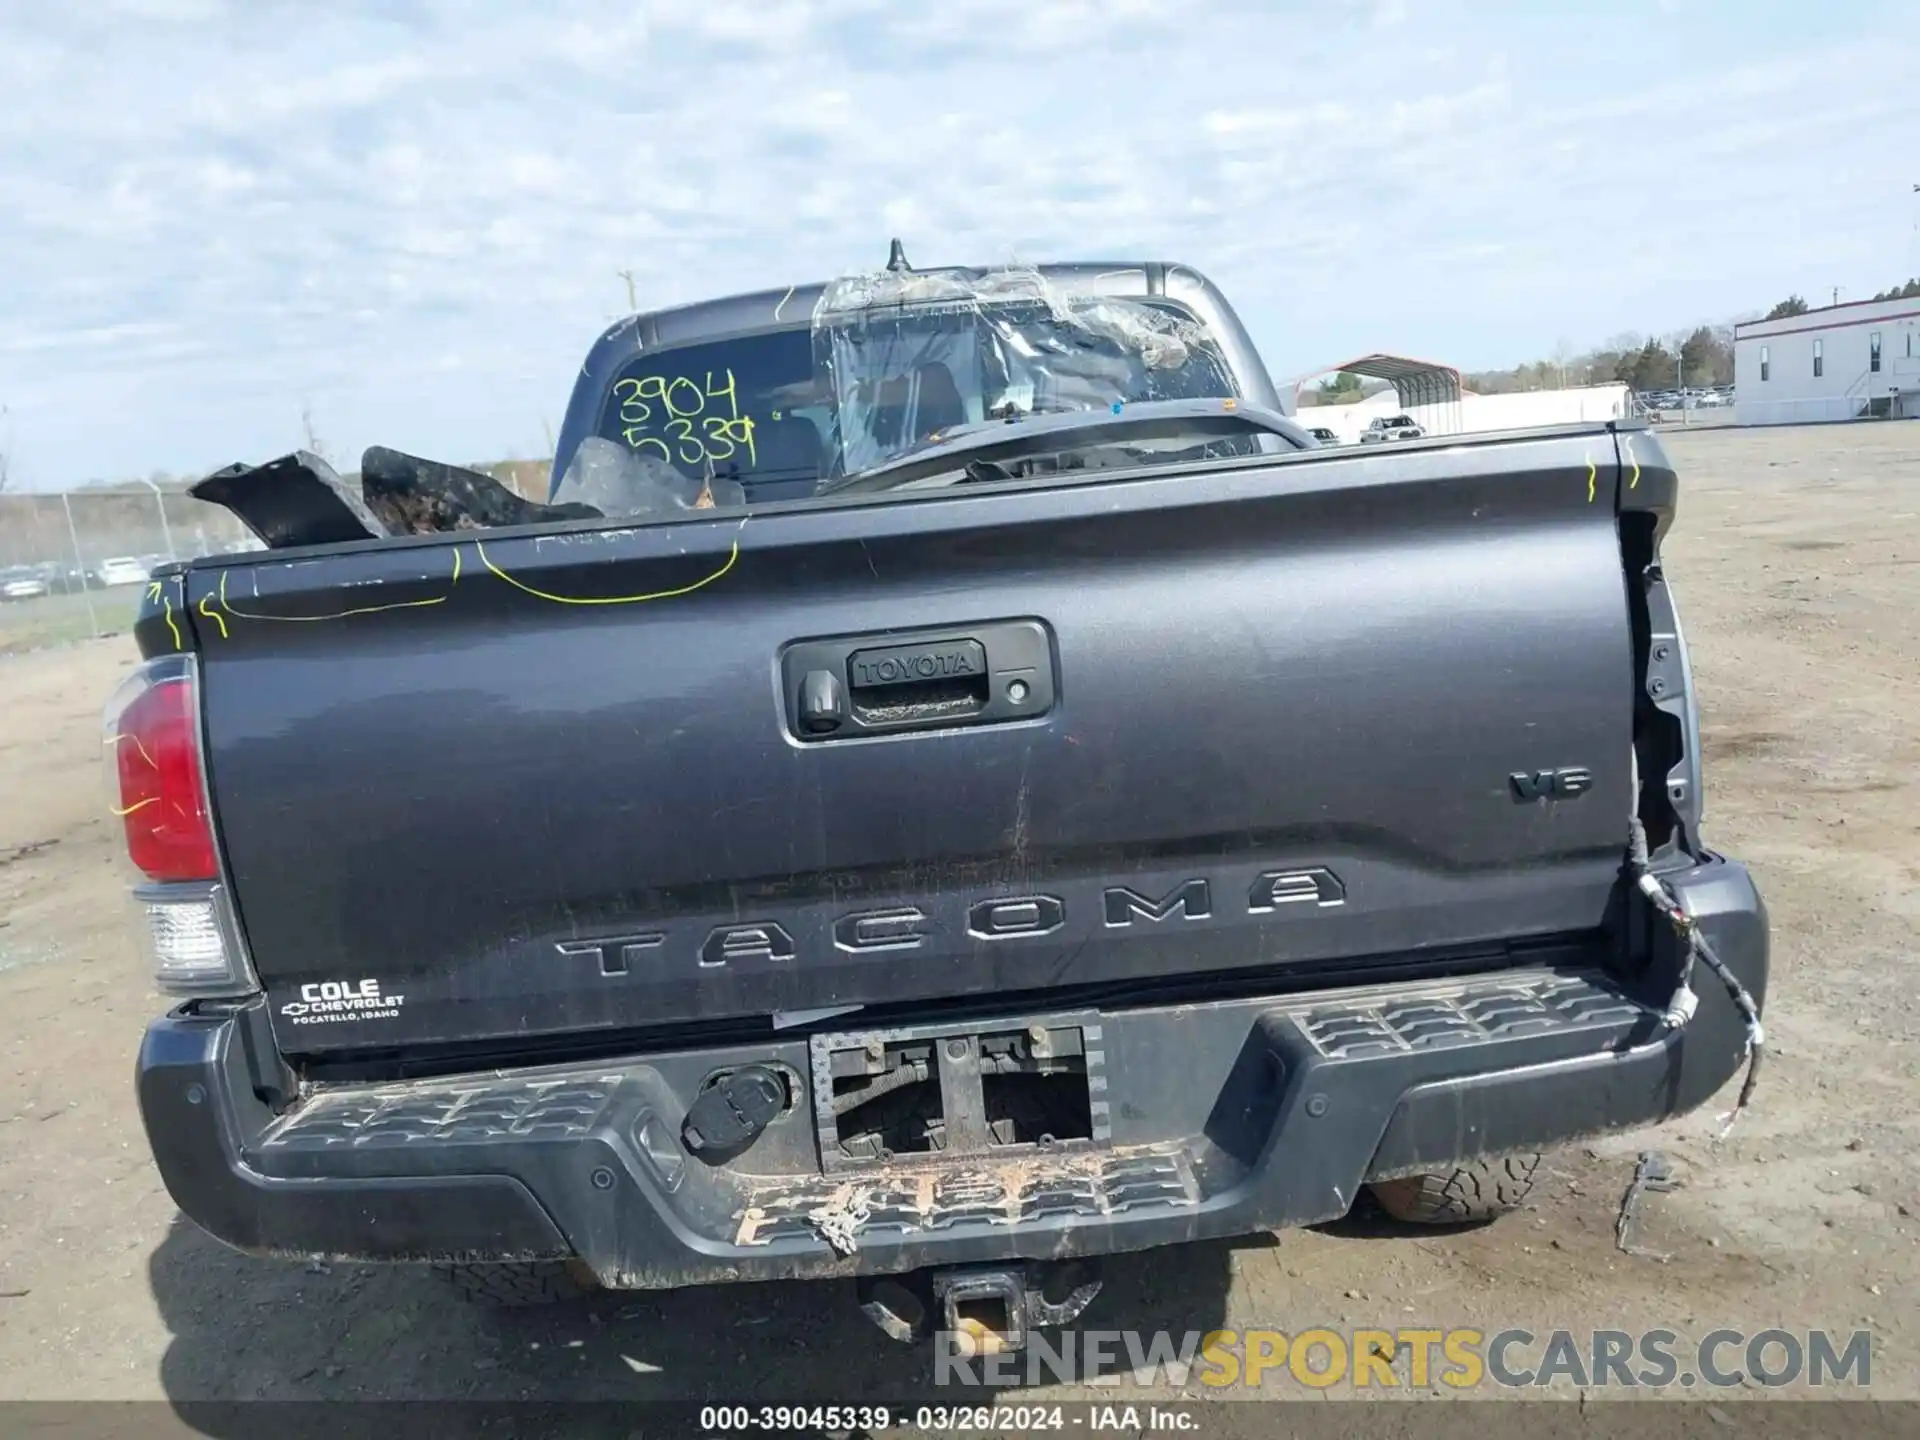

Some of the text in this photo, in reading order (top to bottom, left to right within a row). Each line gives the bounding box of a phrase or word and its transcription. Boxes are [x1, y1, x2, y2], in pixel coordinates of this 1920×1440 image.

[613, 367, 738, 423] 3904
[622, 415, 756, 467] 5339
[858, 652, 974, 683] TOYOTA
[554, 866, 1346, 977] TACOMA
[301, 978, 380, 1002] COLE
[312, 995, 405, 1013] CHEVROLET
[293, 1009, 399, 1025] POCATELLO, IDAHO
